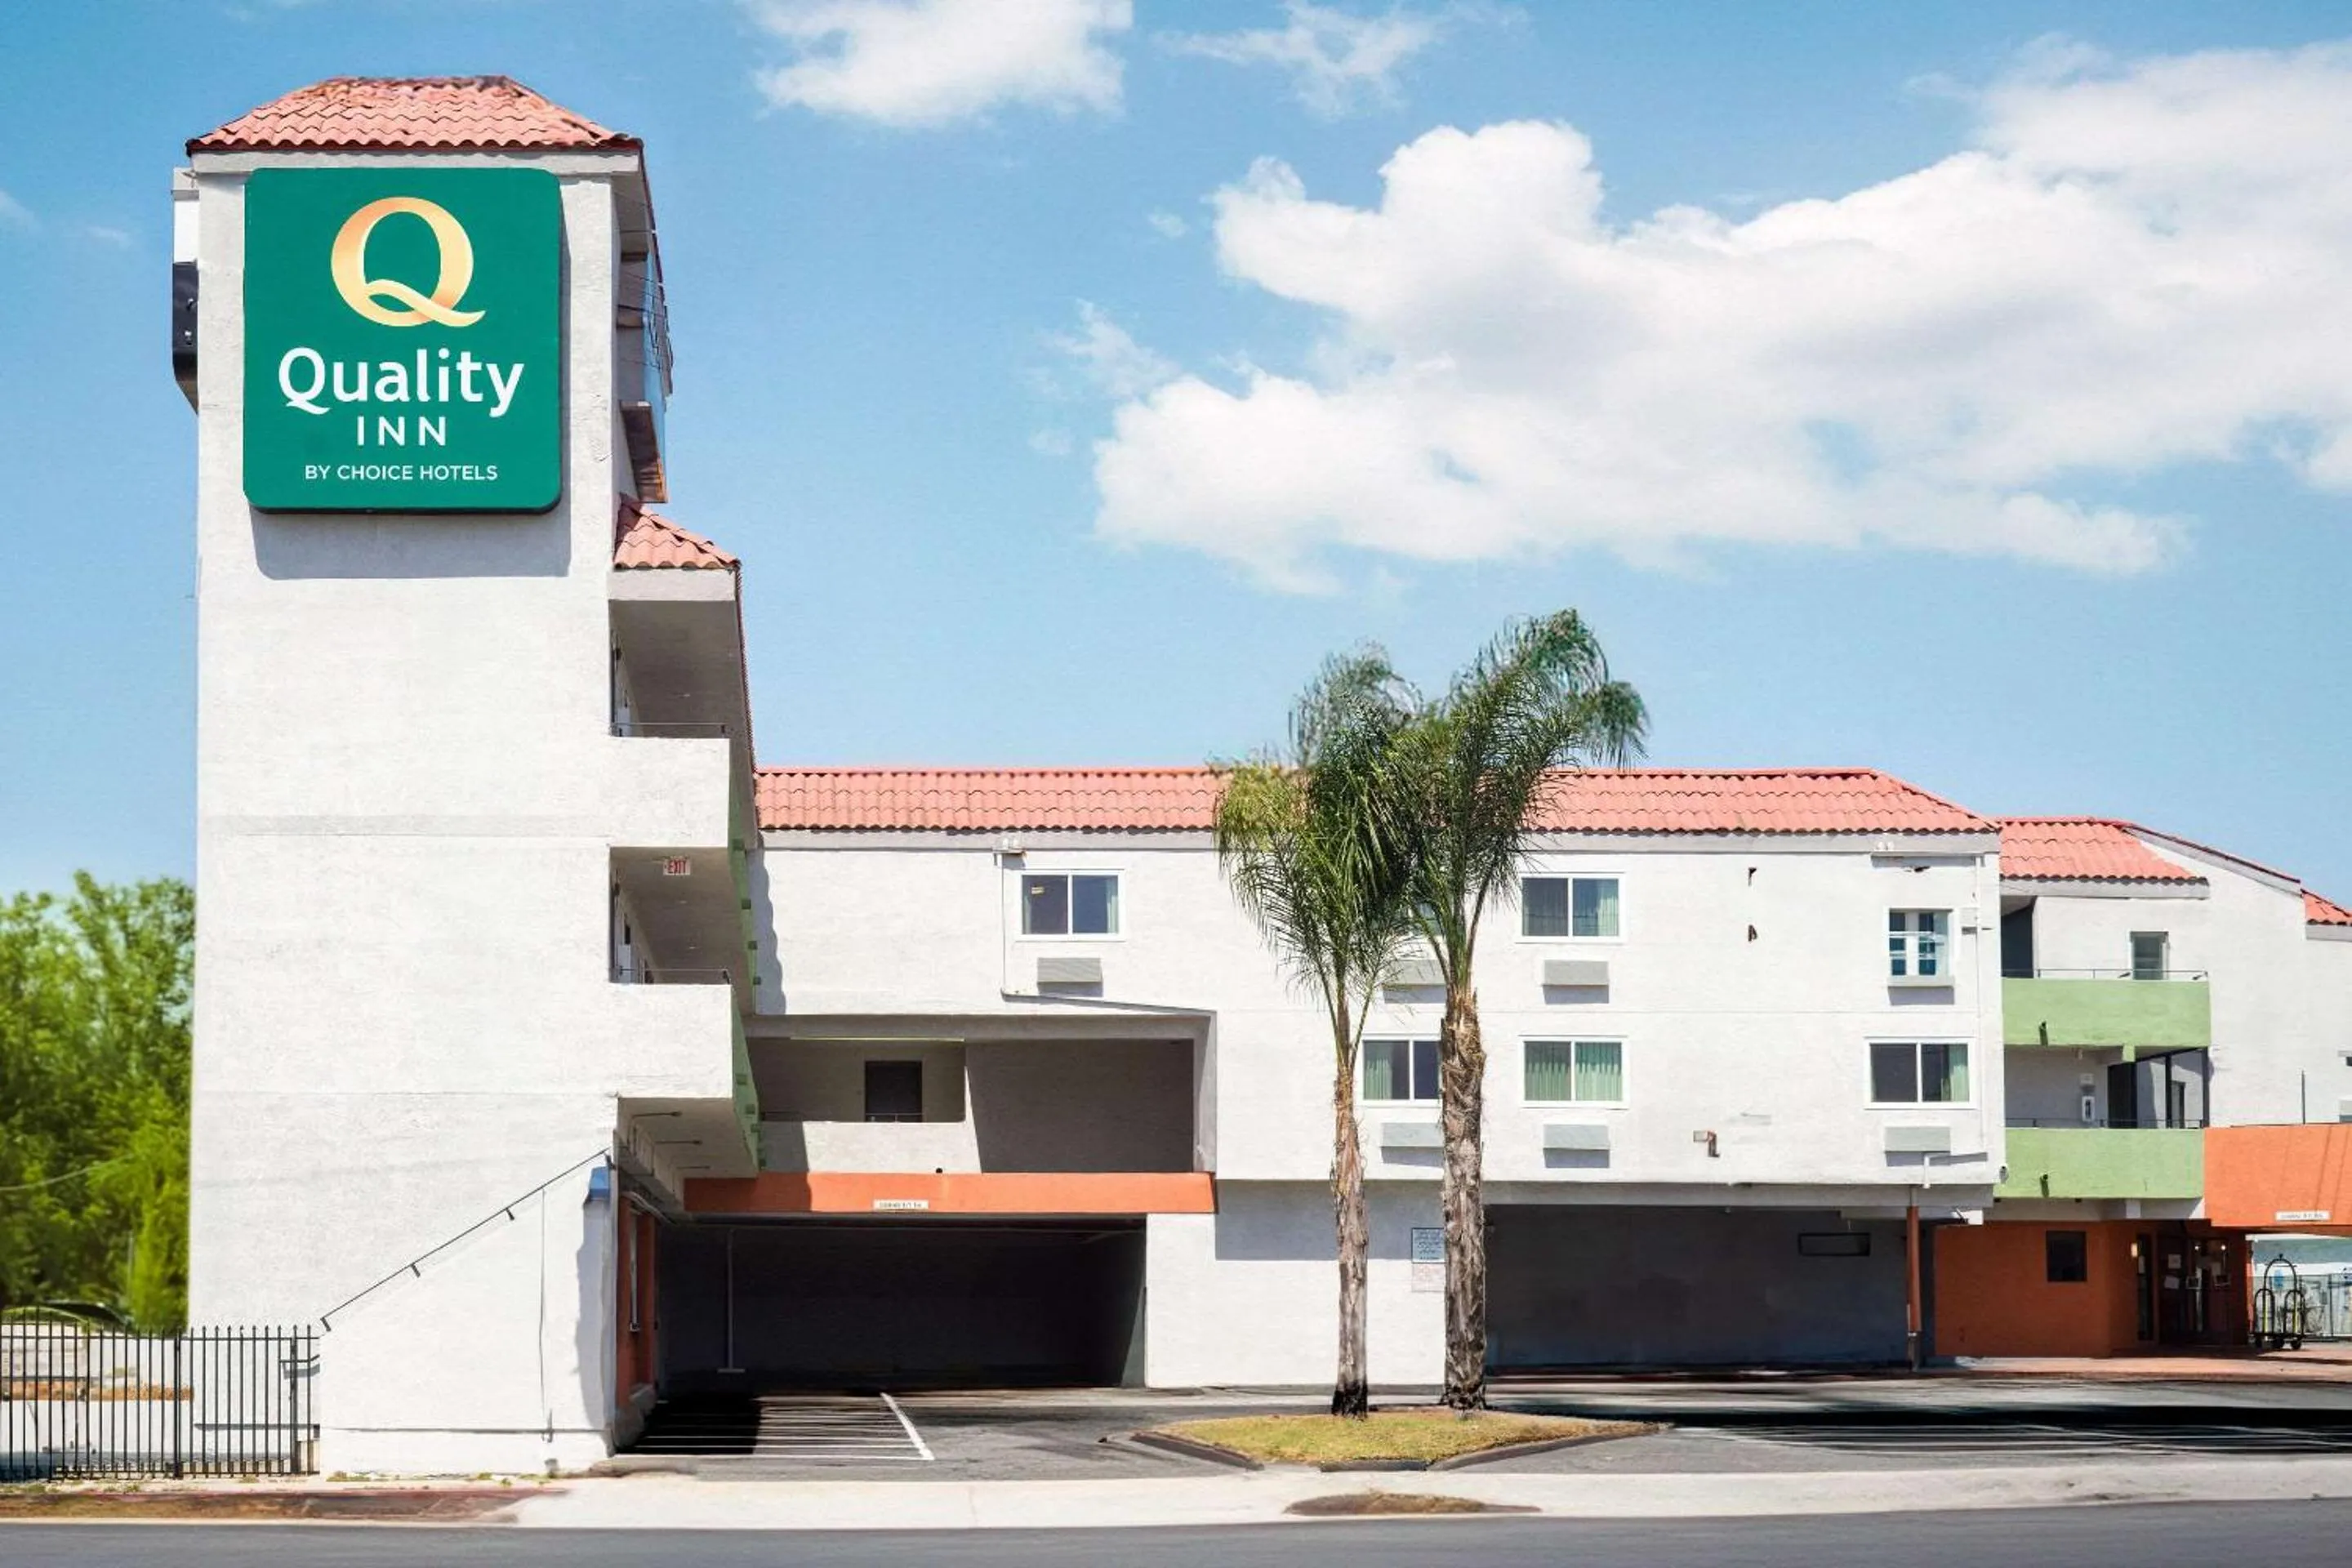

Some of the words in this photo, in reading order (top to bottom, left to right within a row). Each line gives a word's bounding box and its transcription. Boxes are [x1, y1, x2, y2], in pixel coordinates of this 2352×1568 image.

[330, 196, 487, 327] Q
[278, 347, 525, 418] Quality
[356, 416, 447, 446] INN
[305, 465, 331, 480] BY
[336, 465, 414, 480] CHOICE
[420, 465, 498, 480] HOTELS
[667, 860, 687, 874] EXIT
